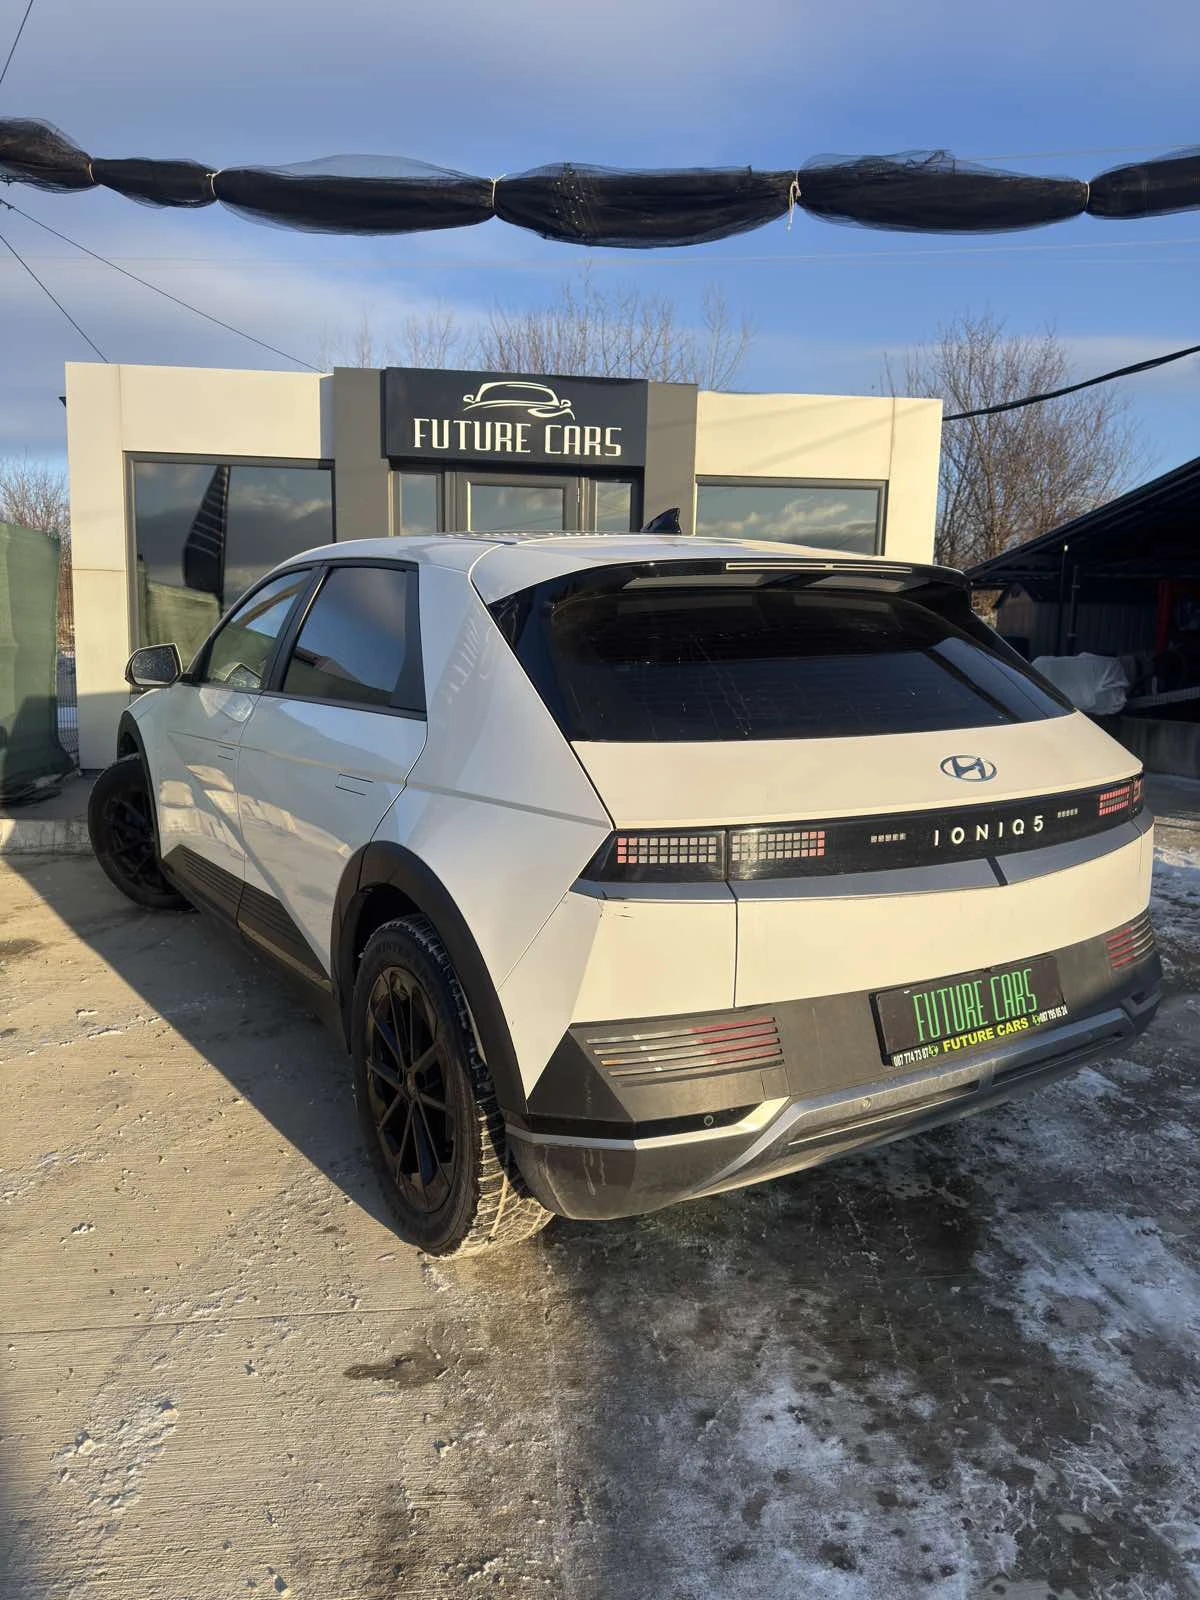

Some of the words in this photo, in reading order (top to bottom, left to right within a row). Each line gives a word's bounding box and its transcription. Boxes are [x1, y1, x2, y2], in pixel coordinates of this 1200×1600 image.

[413, 418, 532, 453] FUTURE
[544, 424, 622, 457] CARS
[933, 818, 1025, 847] IONIQ
[1033, 815, 1044, 832] 5
[912, 979, 989, 1042] FUTURE
[990, 968, 1038, 1021] CARS
[942, 1027, 995, 1052] FUTURE
[997, 1017, 1029, 1036] CARS
